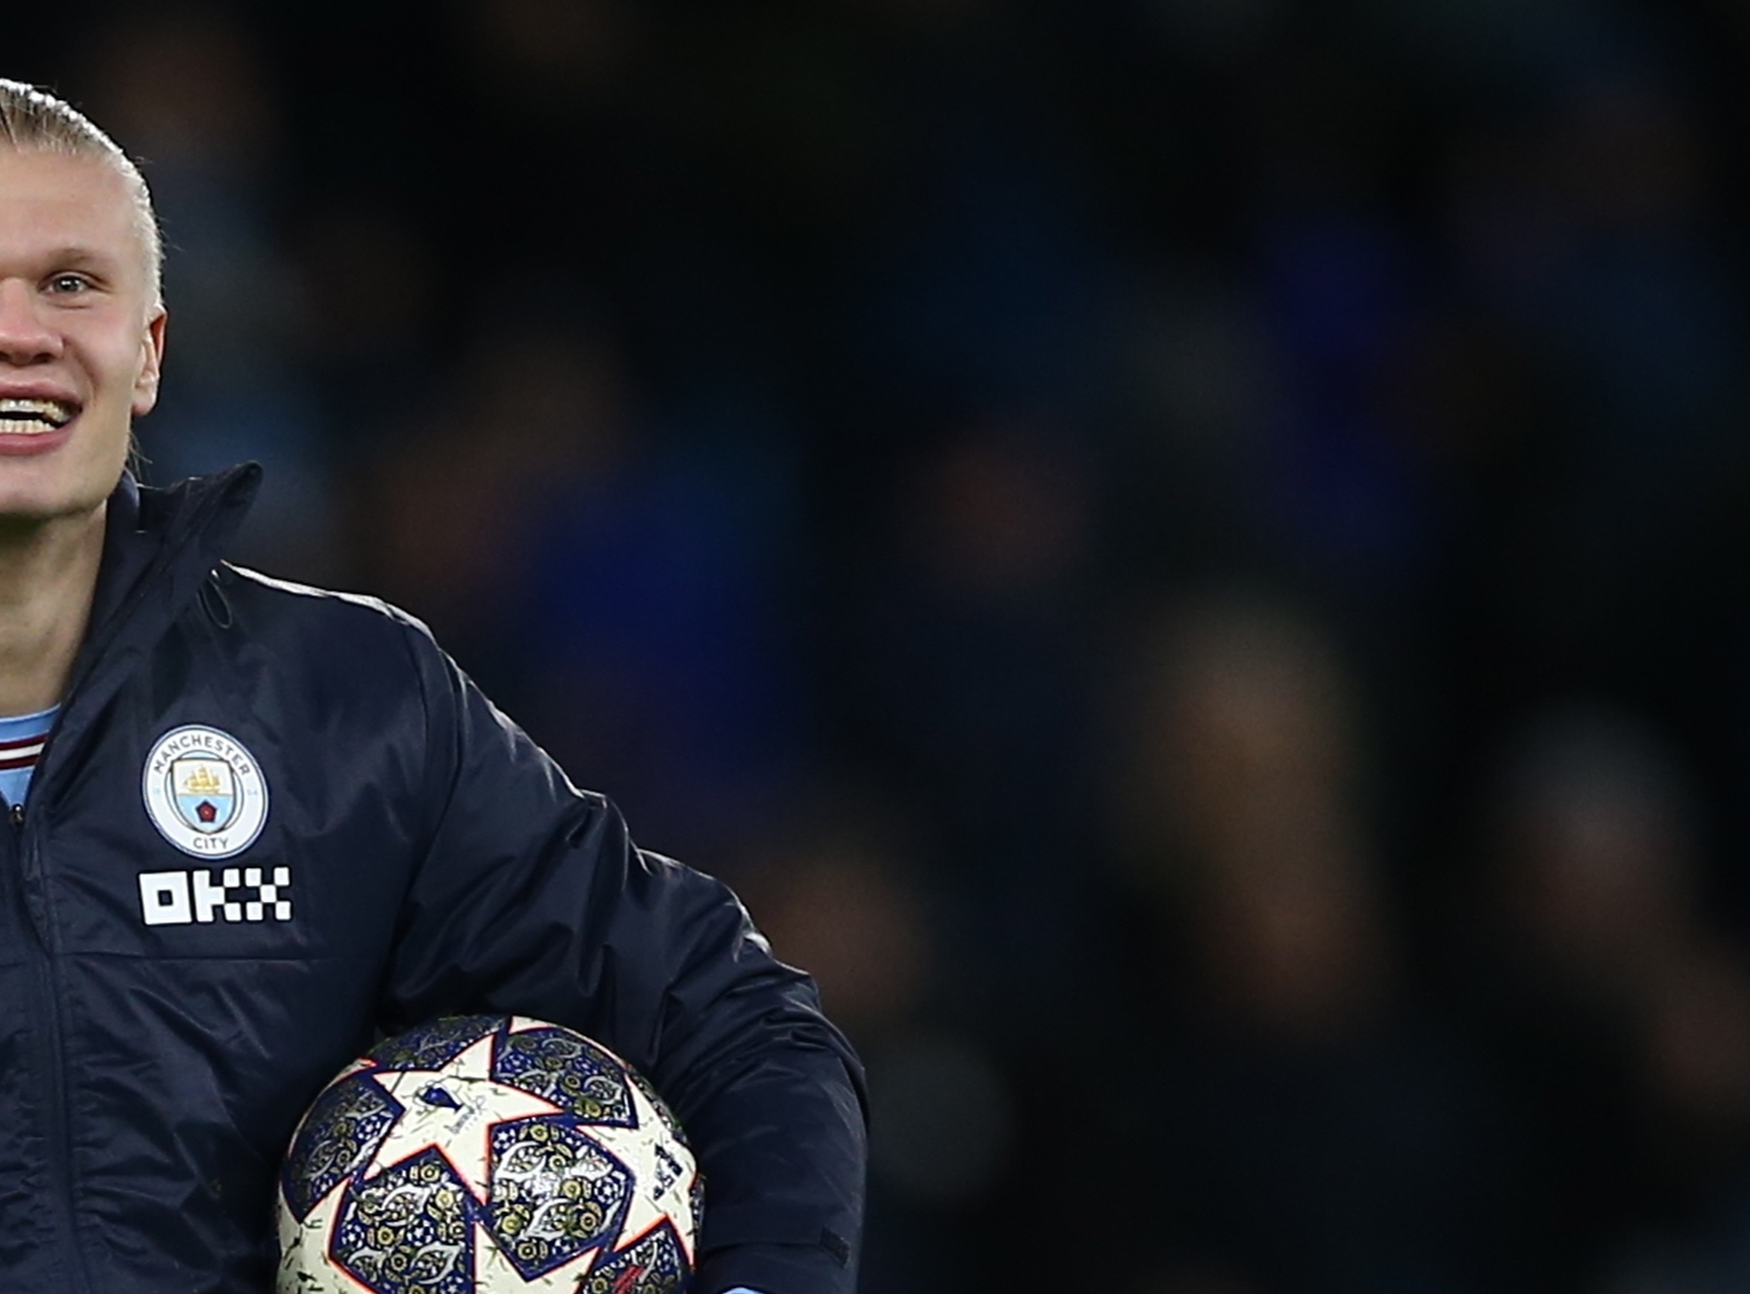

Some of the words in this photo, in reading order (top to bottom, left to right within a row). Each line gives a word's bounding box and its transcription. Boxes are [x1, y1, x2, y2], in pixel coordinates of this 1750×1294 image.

[153, 734, 250, 776] MANCHESTER
[193, 837, 229, 850] CITY
[139, 867, 291, 925] OKX
